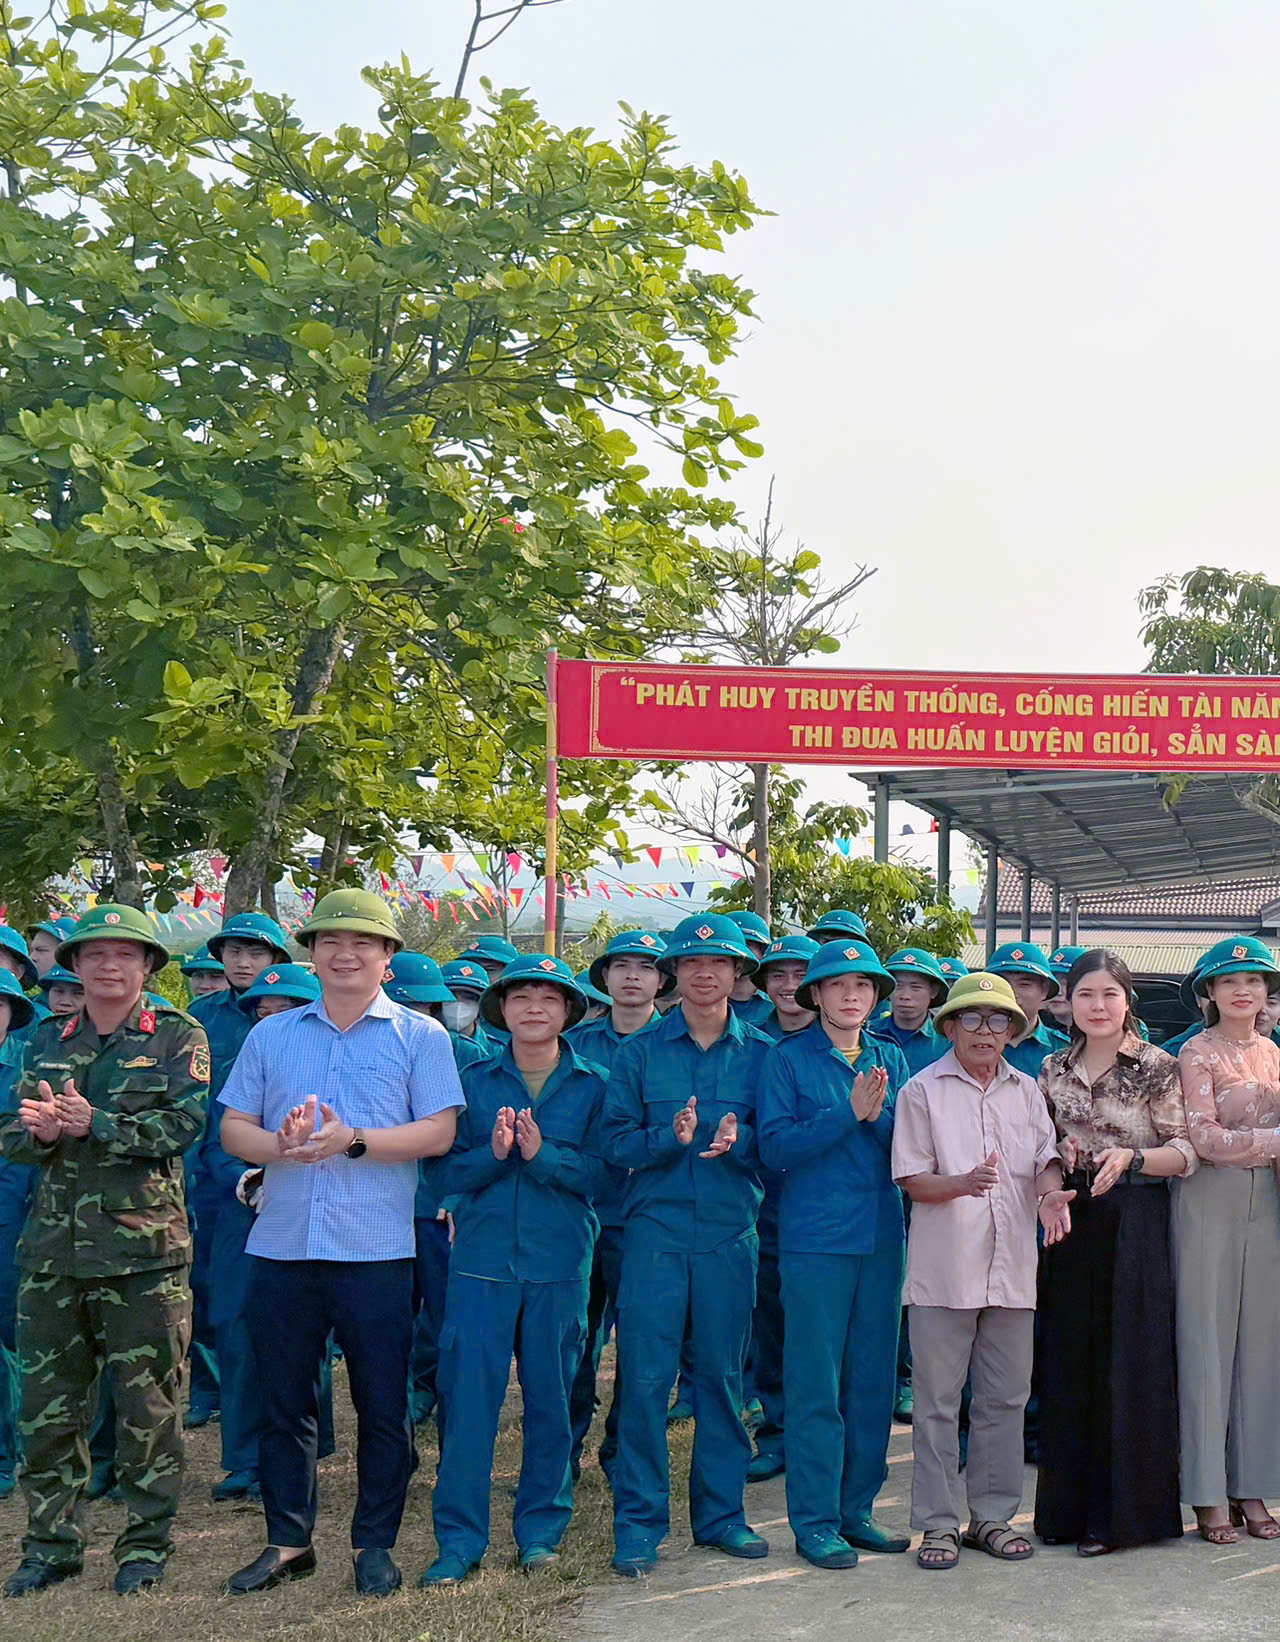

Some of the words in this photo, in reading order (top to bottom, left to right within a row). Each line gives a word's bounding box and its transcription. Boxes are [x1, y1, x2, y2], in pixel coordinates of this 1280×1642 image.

[620, 676, 711, 708] “PHÁT
[719, 685, 776, 709] HUY
[784, 682, 895, 712] TRUYỀN
[903, 684, 1006, 718] THỐNG,
[1015, 685, 1094, 717] CỐNG
[1102, 688, 1169, 719] HIẾN
[1177, 691, 1223, 718] TÀI
[788, 725, 834, 748] THI
[841, 726, 898, 750] ĐUA
[907, 721, 986, 752] HUẤN
[995, 726, 1084, 758] LUYỆN
[1093, 724, 1159, 758] GIỎI,
